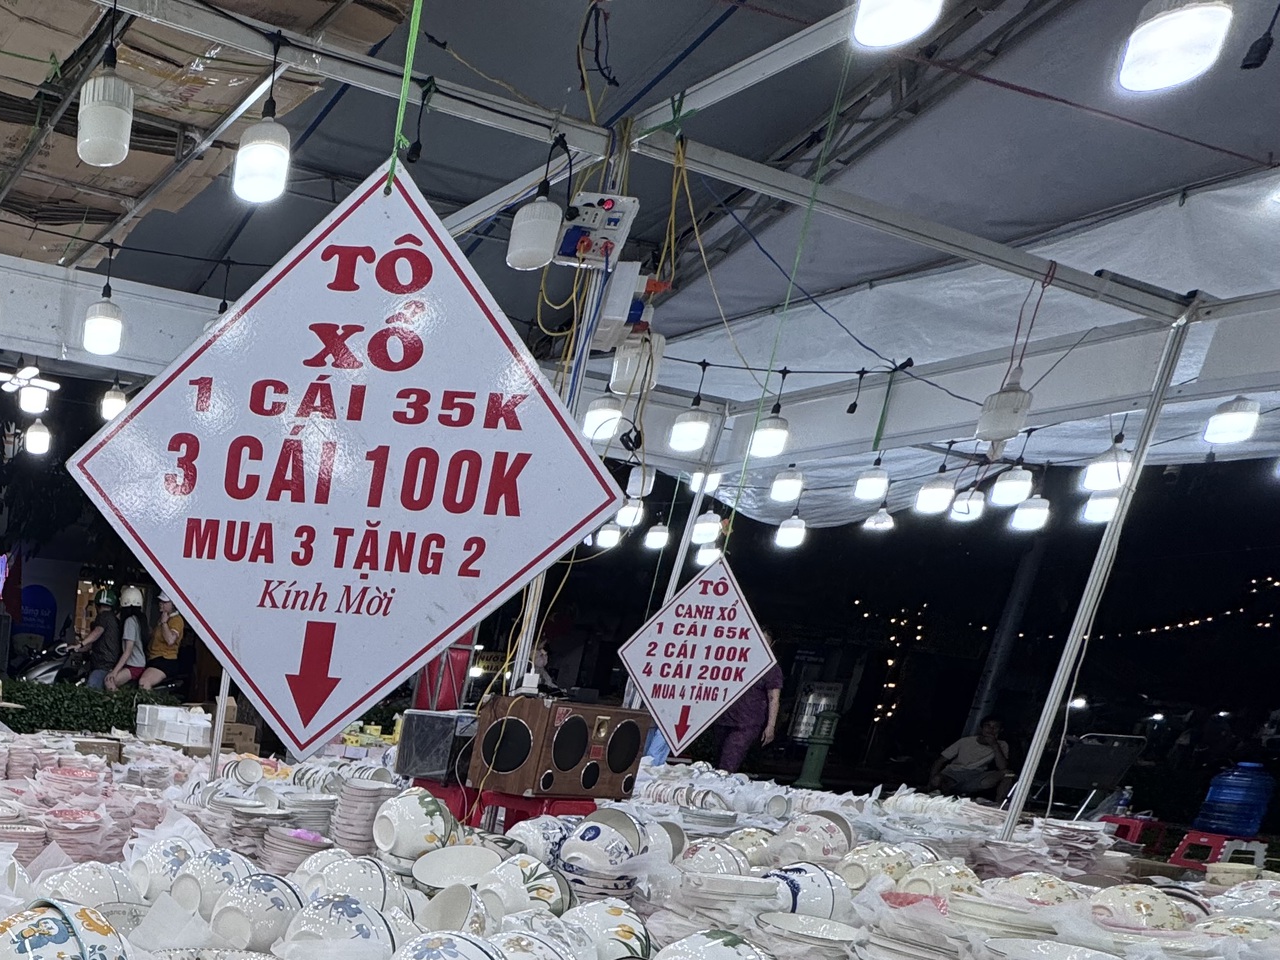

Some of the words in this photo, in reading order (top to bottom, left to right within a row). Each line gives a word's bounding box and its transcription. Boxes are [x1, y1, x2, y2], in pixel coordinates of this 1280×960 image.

[320, 233, 433, 295] TÔ
[302, 300, 424, 372] XỔ
[187, 375, 214, 413] 1
[248, 374, 367, 421] CÁI
[391, 388, 530, 431] 35K
[163, 432, 202, 497] 3
[223, 424, 337, 505] CÁI
[365, 444, 533, 517] 100K
[182, 518, 274, 565] MUA
[290, 525, 317, 567] 3
[332, 520, 444, 580] TẶNG
[457, 536, 487, 578] 2
[257, 579, 330, 614] Kính
[334, 584, 397, 617] Mời
[698, 576, 729, 596] TÔ
[674, 603, 715, 620] CANH
[716, 599, 739, 621] XỔ
[656, 621, 664, 635] 1
[672, 620, 707, 637] CÁI
[713, 626, 752, 640] 65K
[646, 641, 659, 657] 2
[663, 640, 697, 659] CÁI
[704, 644, 752, 663] 100K
[642, 661, 653, 677] 4
[659, 660, 693, 679] CÁI
[697, 665, 747, 683] 200K
[651, 683, 676, 699] MUA
[678, 685, 686, 700] 4
[690, 683, 720, 704] TẶNG
[722, 687, 729, 702] 1
